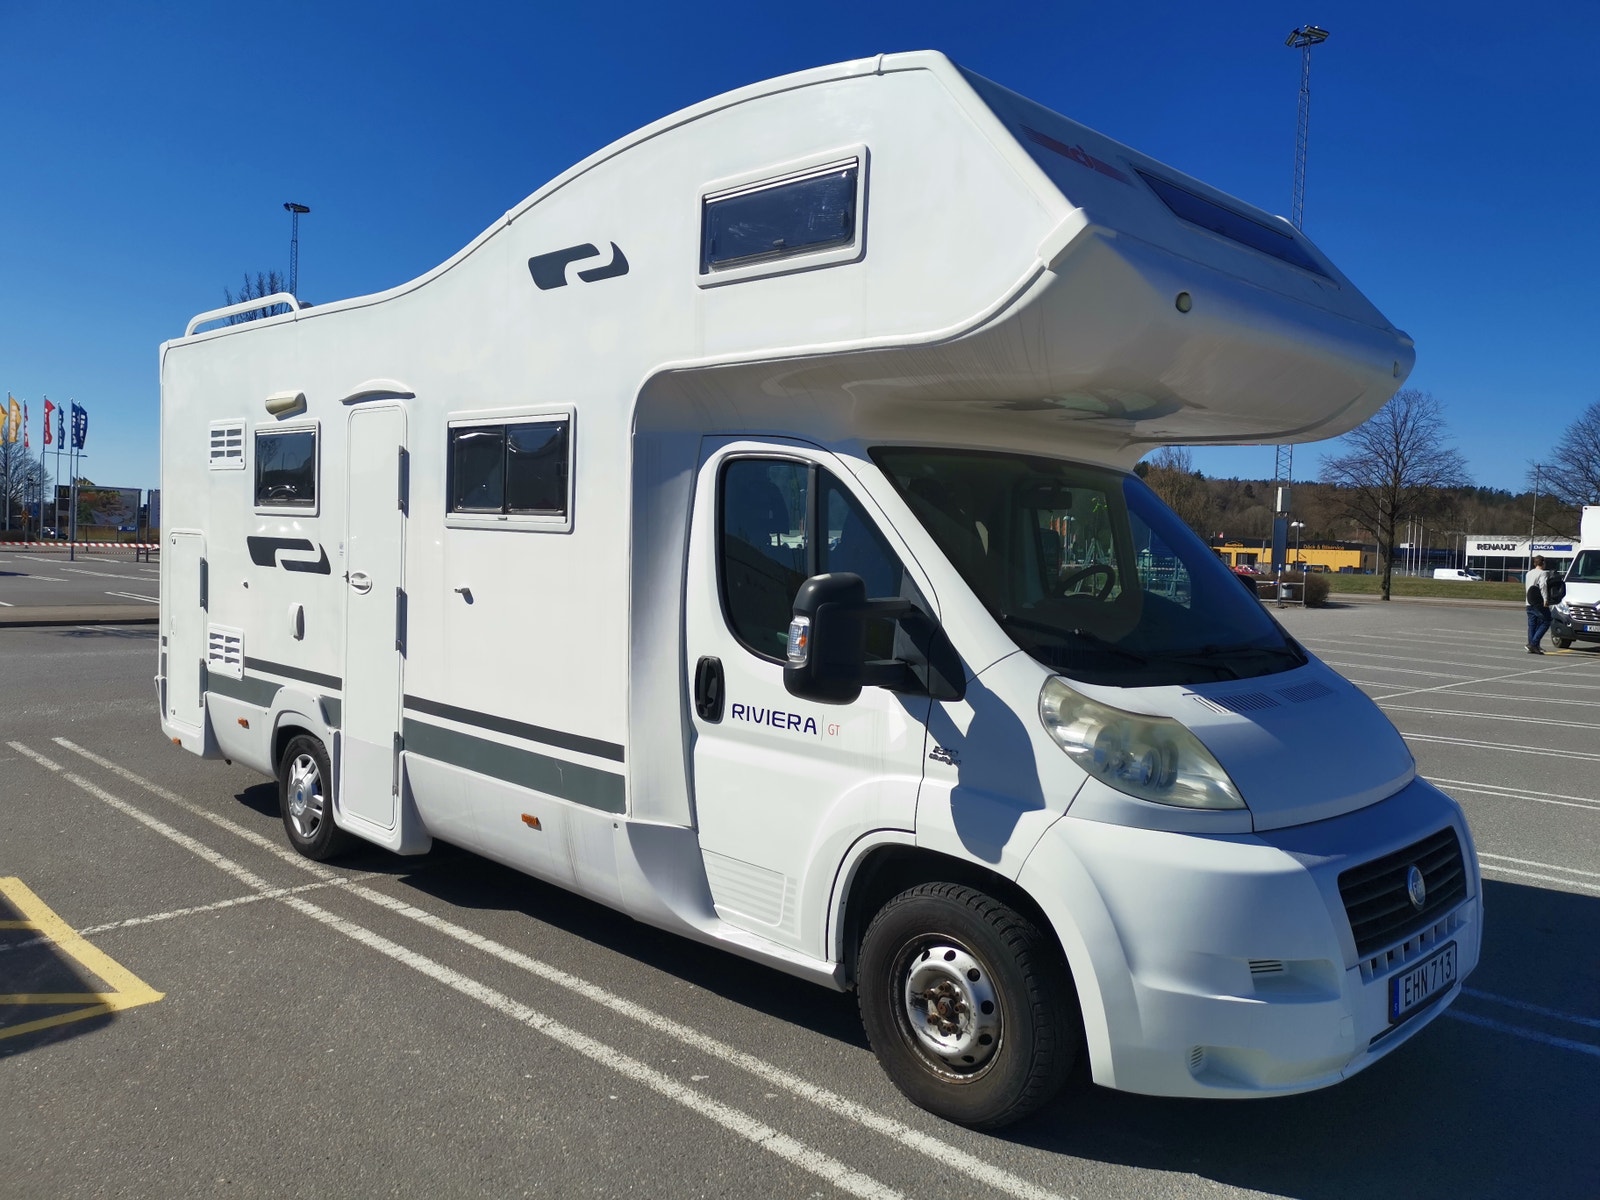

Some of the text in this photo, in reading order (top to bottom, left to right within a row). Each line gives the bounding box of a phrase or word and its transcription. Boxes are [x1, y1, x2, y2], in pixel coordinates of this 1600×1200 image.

[1477, 543, 1517, 551] RENAULT
[732, 703, 817, 735] RIVIERA
[828, 723, 841, 736] GT
[1405, 950, 1452, 1007] EHN 713
